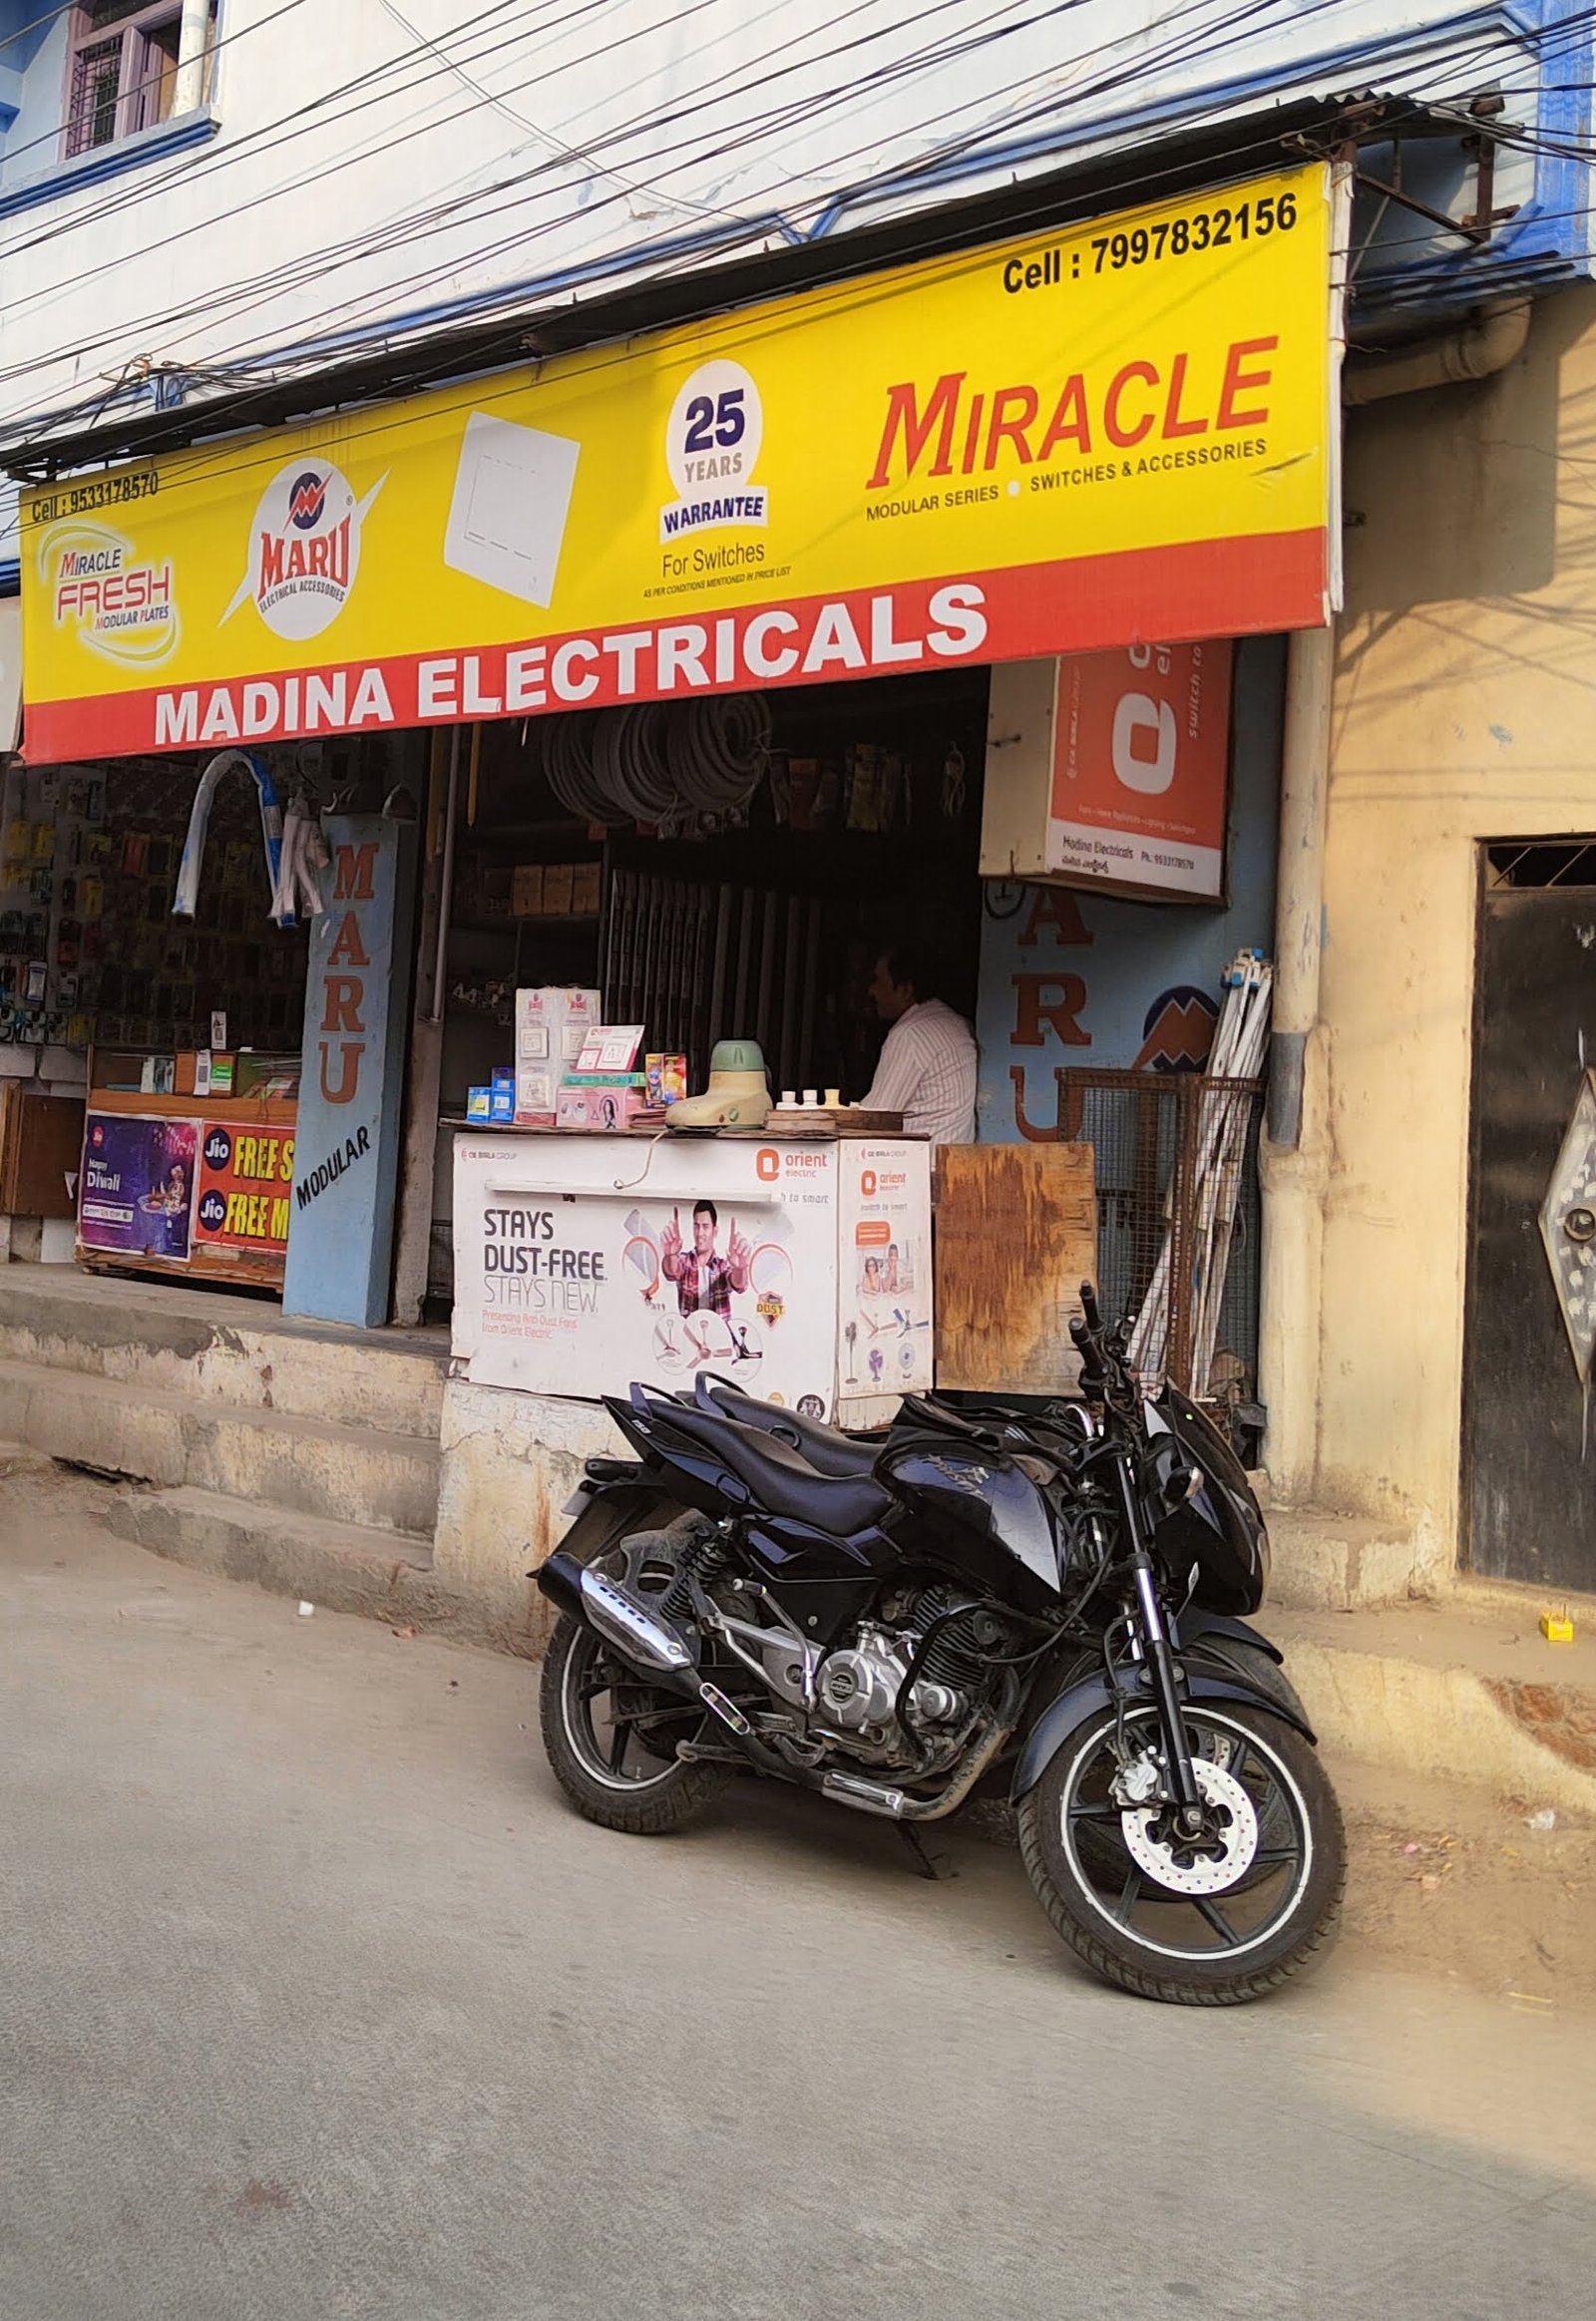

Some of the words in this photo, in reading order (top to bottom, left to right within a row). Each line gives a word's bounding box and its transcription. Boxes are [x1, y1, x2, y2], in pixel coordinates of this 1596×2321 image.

[1002, 248, 1060, 293] Cell
[1091, 193, 1297, 274] 7997832156
[684, 388, 745, 454] 25
[865, 335, 1279, 490] MIRACLE
[684, 452, 743, 484] YEARS
[866, 496, 940, 522] MODULAR
[944, 485, 998, 508] SERIES
[1029, 464, 1116, 492] SWITCHES
[1120, 461, 1132, 476] &
[1136, 438, 1267, 475] ACCESSORIES
[32, 496, 57, 522] Cell
[70, 472, 159, 513] 9533178570
[663, 496, 764, 534] WARRANTEE
[59, 549, 121, 579] MIRACLE
[256, 512, 351, 602] MARU
[662, 554, 688, 578] For
[693, 543, 765, 573] Switches
[58, 567, 169, 620] FRESH
[258, 581, 298, 613] ELECTRICAL
[299, 580, 346, 602] ACCESSORIES
[643, 589, 651, 598] AS
[653, 585, 666, 597] PER
[666, 580, 705, 595] CONDITIONS
[706, 573, 746, 588] MENTIONED
[746, 572, 754, 581] IN
[754, 569, 776, 580] PRICE
[775, 566, 791, 577] LIST
[95, 610, 138, 629] MODULAR
[140, 605, 170, 623] PLATES
[155, 667, 395, 745] MADINA
[418, 583, 988, 718] ELECTRICALS
[318, 843, 380, 1104] MARU
[205, 1138, 229, 1159] Jio
[232, 1135, 279, 1180] FREE
[296, 1124, 371, 1211] MODULAR
[785, 1151, 828, 1167] orient
[785, 1169, 817, 1178] electric
[87, 1171, 121, 1192] Diwali
[802, 1194, 830, 1204] smart
[200, 1198, 224, 1220] Jio
[223, 1192, 270, 1238] FREE
[484, 1209, 554, 1240] STAYS
[484, 1274, 546, 1308] STAYS
[756, 1304, 784, 1315] DUST
